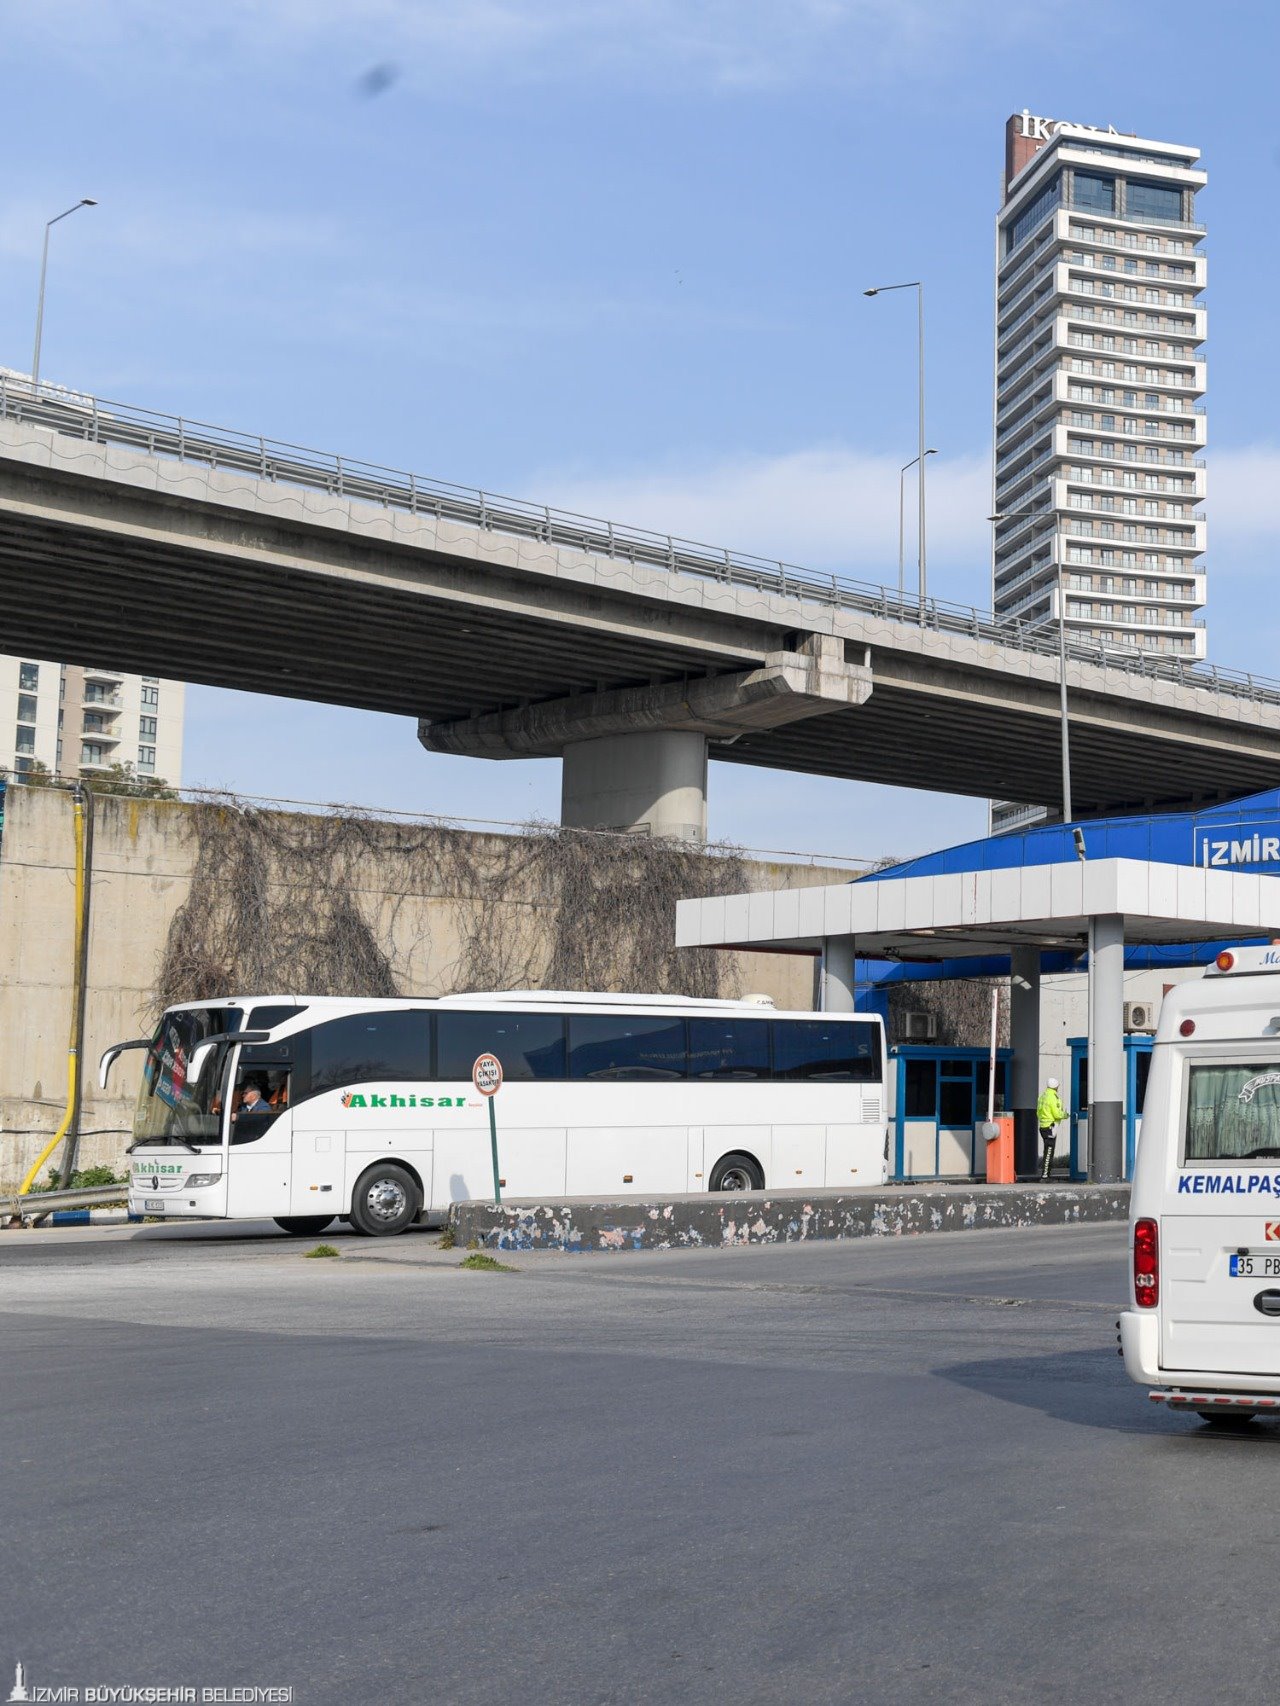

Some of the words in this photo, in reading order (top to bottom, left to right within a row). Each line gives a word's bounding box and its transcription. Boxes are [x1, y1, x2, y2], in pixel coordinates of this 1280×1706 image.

[1202, 833, 1280, 868] İZMİR
[348, 1093, 467, 1108] Akhisar
[1238, 1258, 1254, 1275] 35
